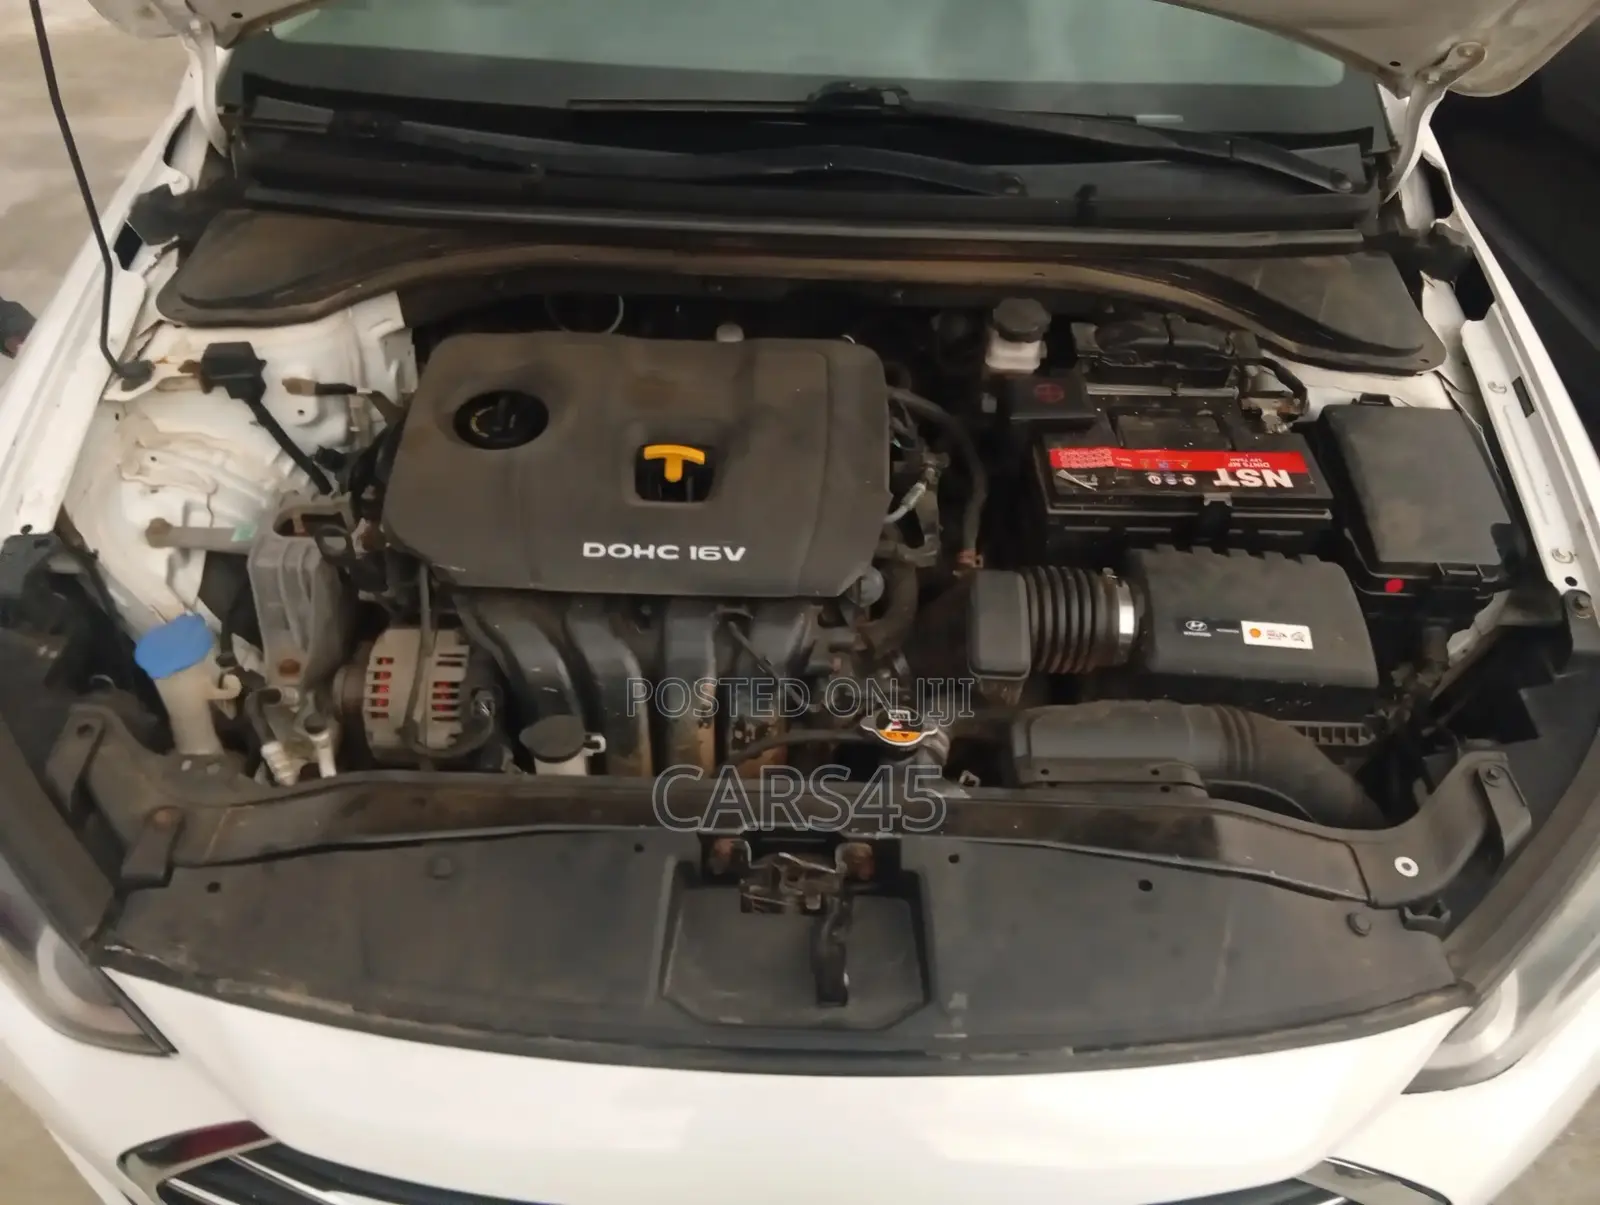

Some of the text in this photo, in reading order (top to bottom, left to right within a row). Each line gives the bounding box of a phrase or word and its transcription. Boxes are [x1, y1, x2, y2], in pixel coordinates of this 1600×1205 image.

[1213, 468, 1294, 488] NST
[582, 542, 746, 562] DOHC 16V
